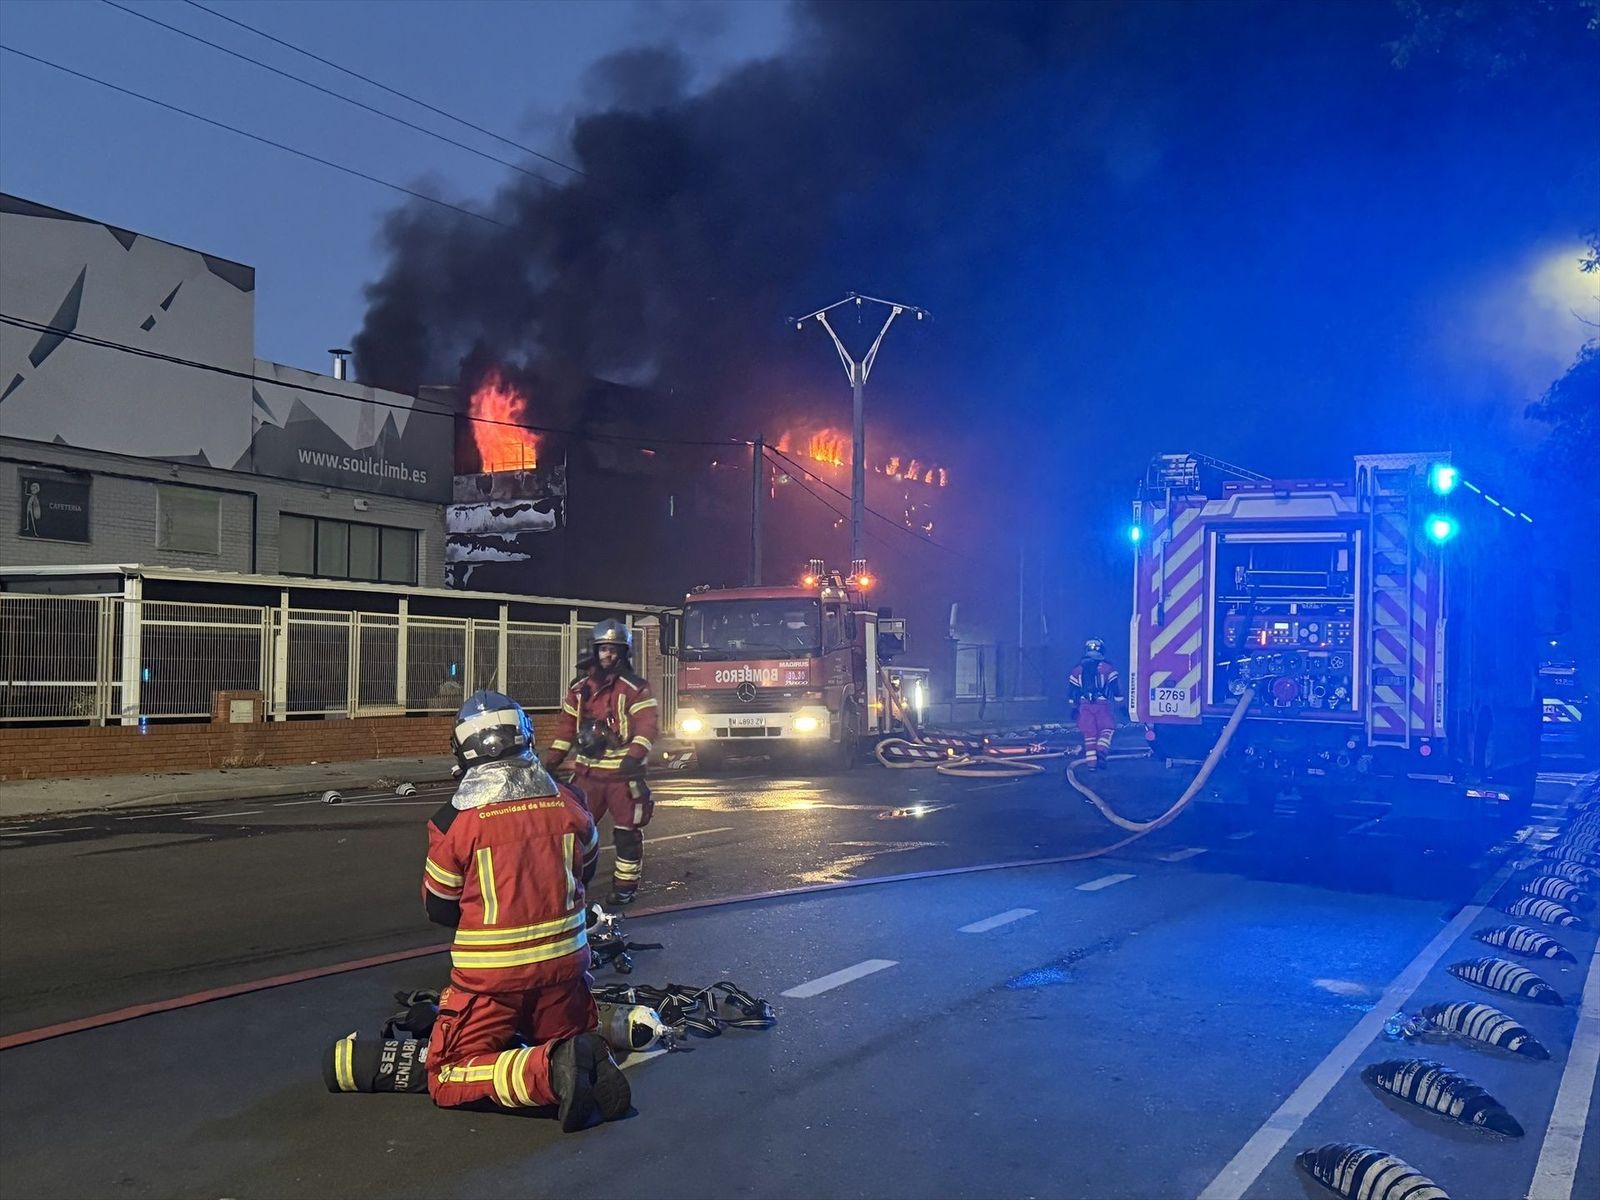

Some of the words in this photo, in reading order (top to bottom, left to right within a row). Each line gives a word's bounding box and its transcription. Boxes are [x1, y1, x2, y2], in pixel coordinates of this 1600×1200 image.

[298, 449, 427, 484] www.soulclimb.es
[1159, 690, 1185, 701] 2769
[1159, 702, 1179, 713] LGJ
[479, 804, 527, 819] Comunidad
[527, 802, 538, 810] de
[380, 1040, 398, 1075] SEIS
